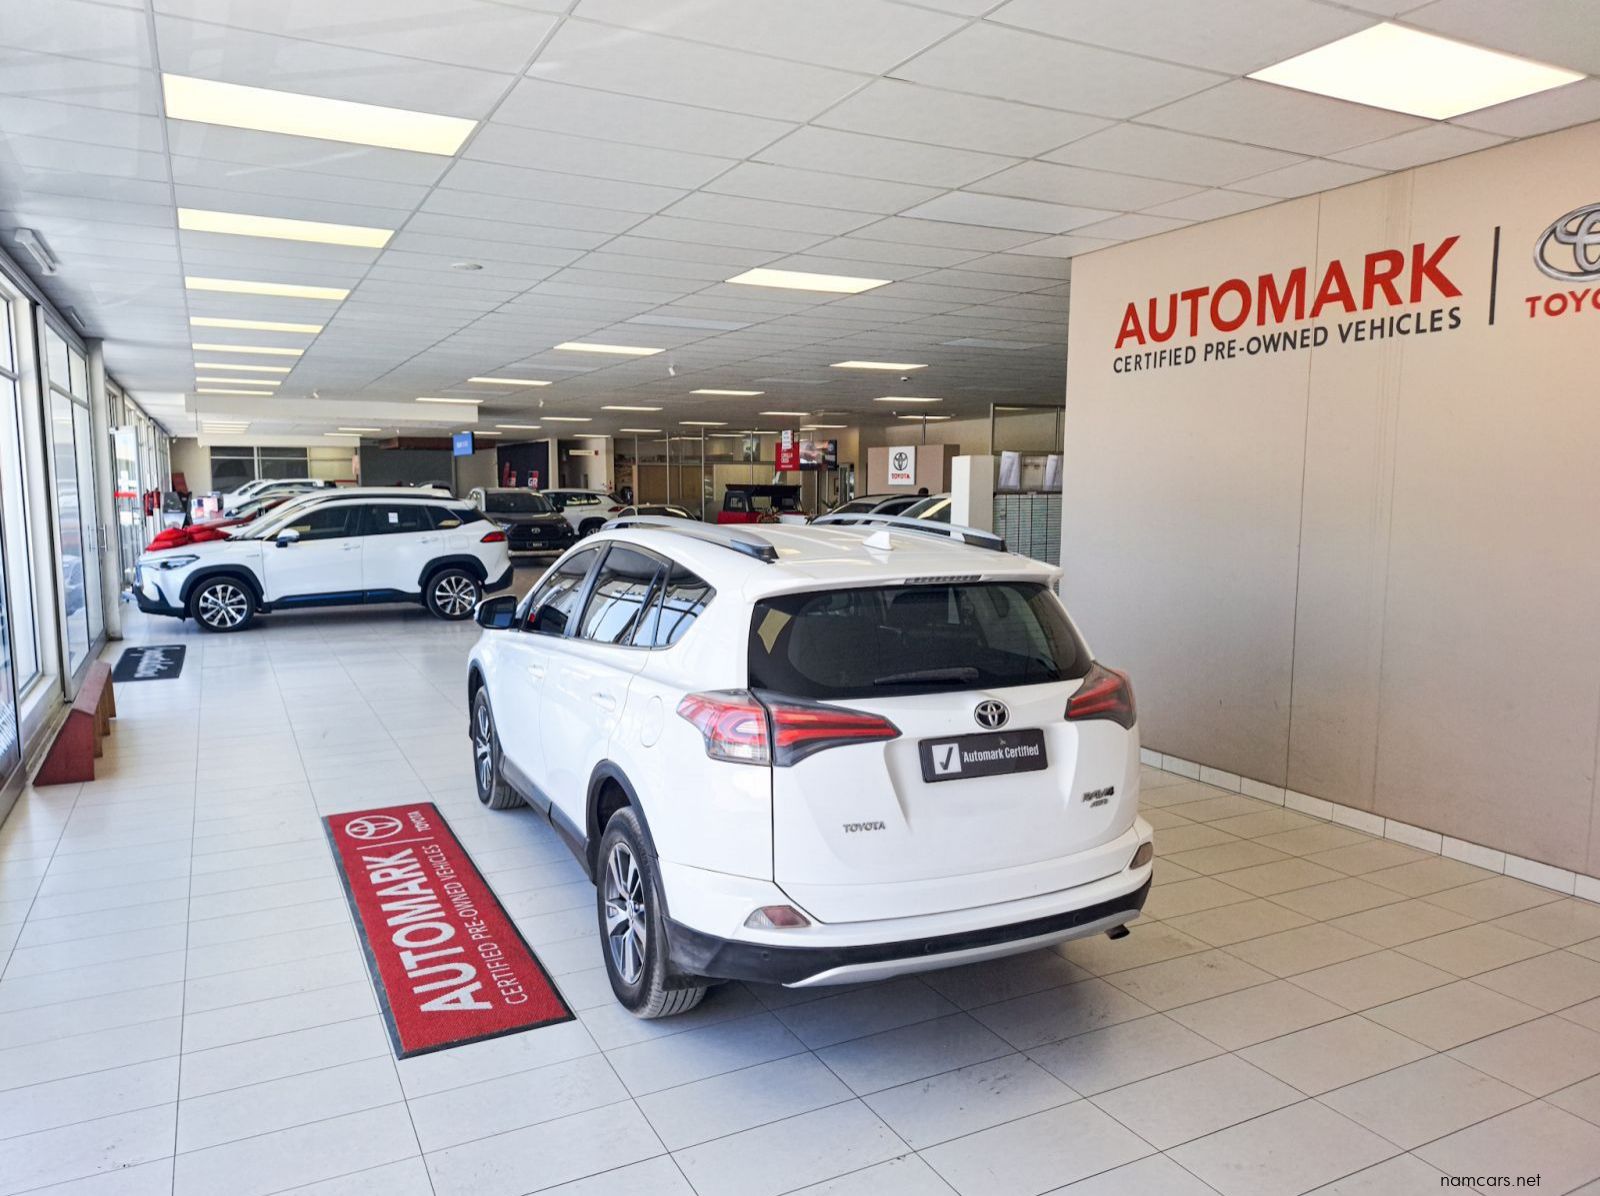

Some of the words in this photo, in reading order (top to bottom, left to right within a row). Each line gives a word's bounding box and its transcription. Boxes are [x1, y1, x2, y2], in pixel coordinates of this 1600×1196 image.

[1114, 235, 1463, 349] AUTOMARK
[1113, 346, 1197, 374] CERTIFIED
[1203, 325, 1329, 362] PRE-OWNED
[1337, 306, 1462, 344] VEHICLES
[891, 472, 911, 480] TOYOTA
[963, 746, 1004, 763] Automark
[1005, 744, 1039, 759] Certified
[843, 821, 885, 833] TOYOTA
[422, 844, 457, 881] VEHICLES
[361, 847, 493, 1012] AUTOMARK
[443, 881, 491, 940] PRE-OWNED
[478, 941, 528, 1005] CERTIFIED
